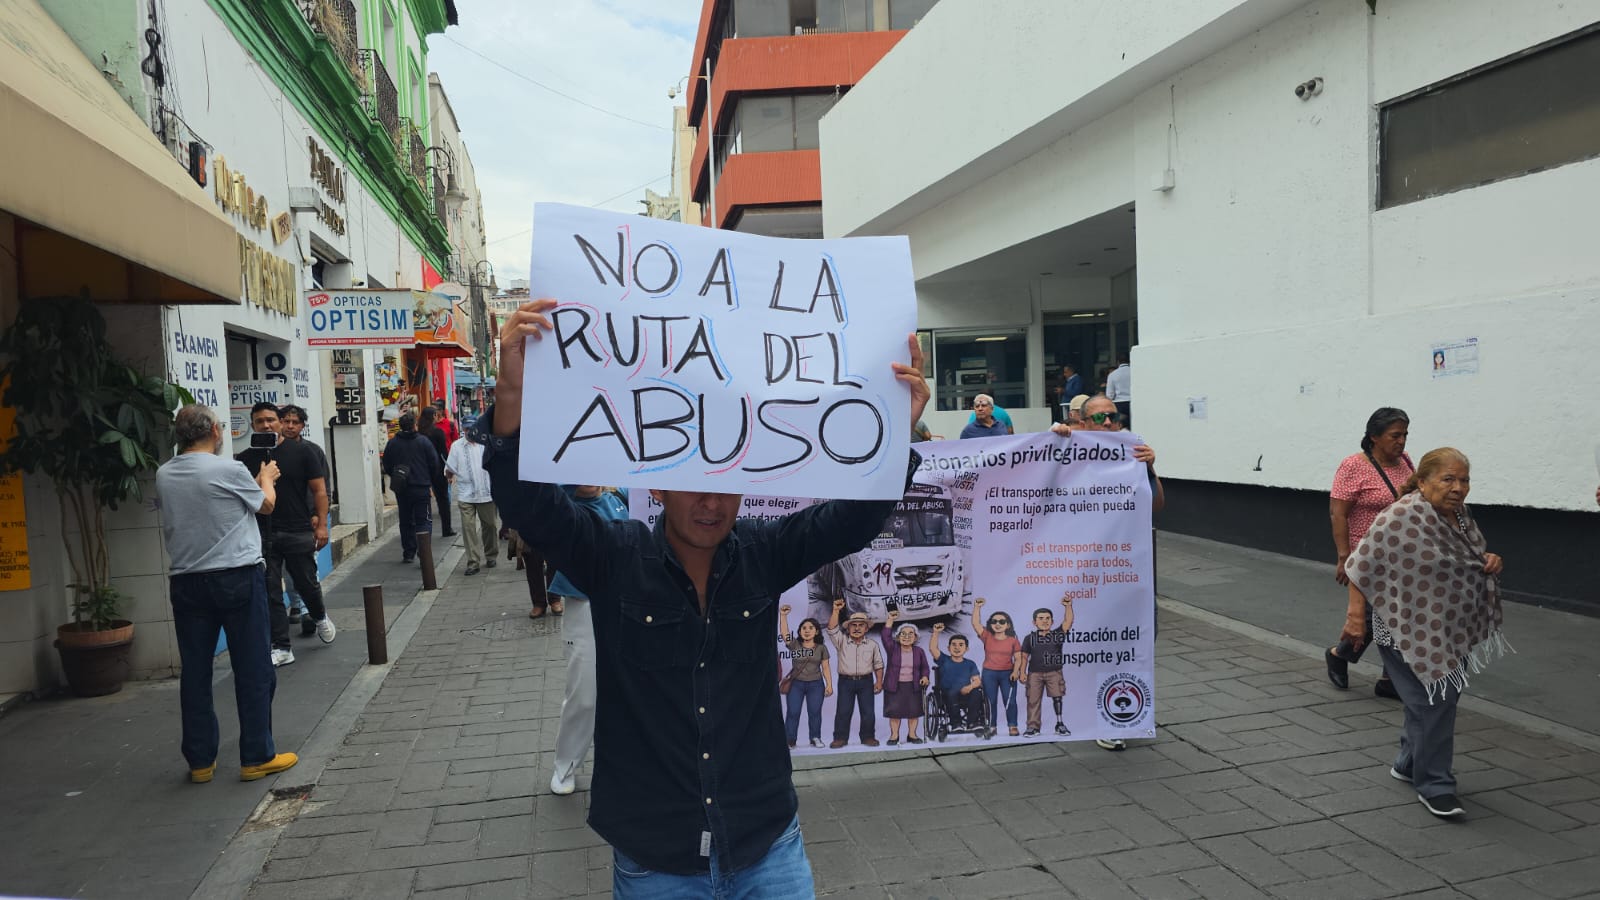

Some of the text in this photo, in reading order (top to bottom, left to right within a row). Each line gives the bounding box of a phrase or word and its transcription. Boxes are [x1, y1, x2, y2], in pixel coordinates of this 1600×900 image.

[574, 232, 845, 323] NO A LA
[334, 296, 382, 307] OPTICAS
[311, 309, 408, 332] OPTISIM
[175, 332, 218, 358] EXAMEN
[551, 307, 863, 388] RUTA DEL
[185, 362, 214, 382] DE LA
[231, 391, 278, 405] PTISIM
[552, 387, 883, 472] ABUSO
[1011, 443, 1126, 469] privilegiados!
[954, 471, 980, 482] TARIFA
[951, 480, 975, 491] JUSTA
[985, 487, 999, 501] ¡El
[1002, 486, 1053, 499] transporte
[1056, 488, 1068, 497] es
[1072, 487, 1086, 496] un
[1089, 484, 1137, 497] derecho,
[744, 498, 765, 509] que
[768, 498, 800, 509] elegir
[908, 502, 919, 511] DEL
[990, 499, 1136, 517] no un lujo para quien pueda
[989, 518, 1033, 533] pagarlo!
[1020, 542, 1132, 556] ¡Si el transporte no es
[1025, 556, 1133, 571] accesible para todos,
[1017, 571, 1139, 586] entonces no hay justicia
[882, 590, 954, 607] TARIFA EXCESIVA
[1064, 588, 1097, 600] social!
[786, 630, 794, 642] al
[1031, 626, 1140, 648] ¡Estatización del
[780, 647, 814, 659] nuestra
[1043, 647, 1136, 667] transporte ya!
